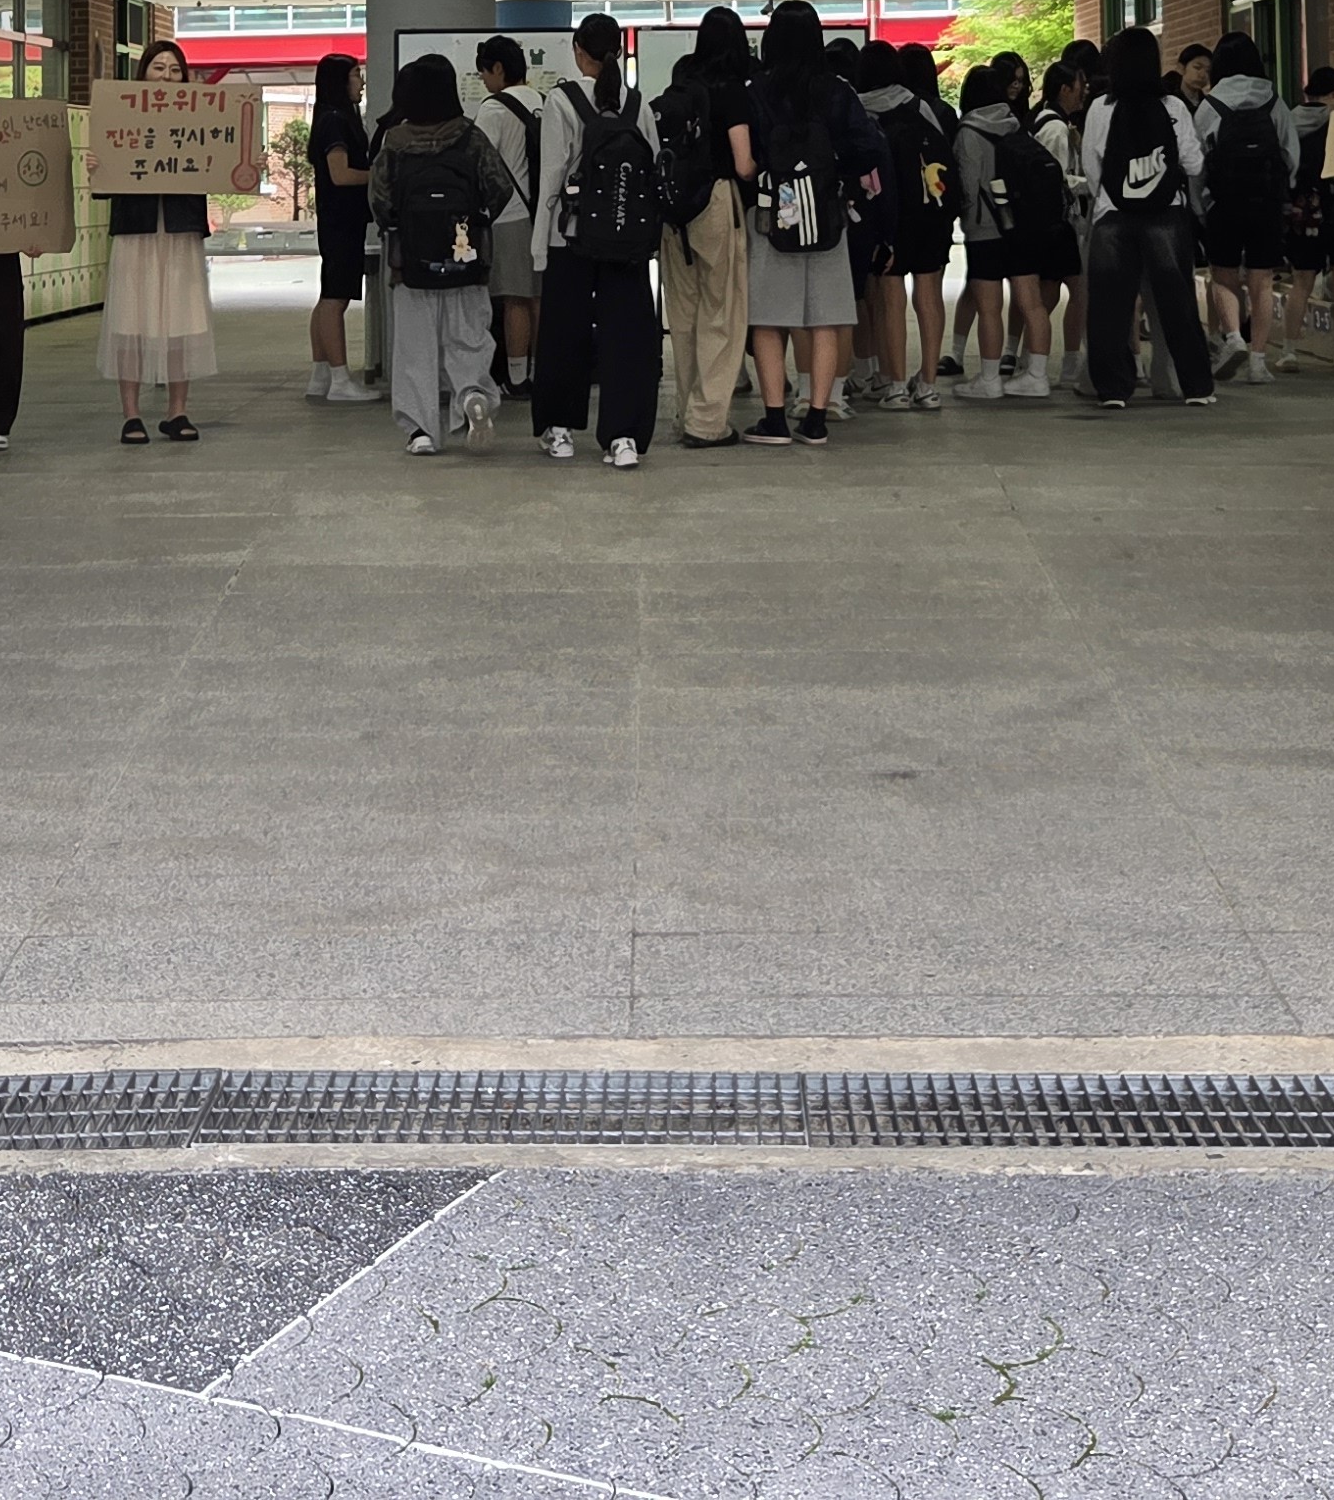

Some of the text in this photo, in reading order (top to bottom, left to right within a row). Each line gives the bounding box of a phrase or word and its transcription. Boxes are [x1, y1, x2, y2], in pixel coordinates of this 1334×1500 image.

[120, 88, 226, 113] 기후위기
[105, 126, 236, 150] 진실을 직시해
[130, 154, 214, 181] 주세요!
